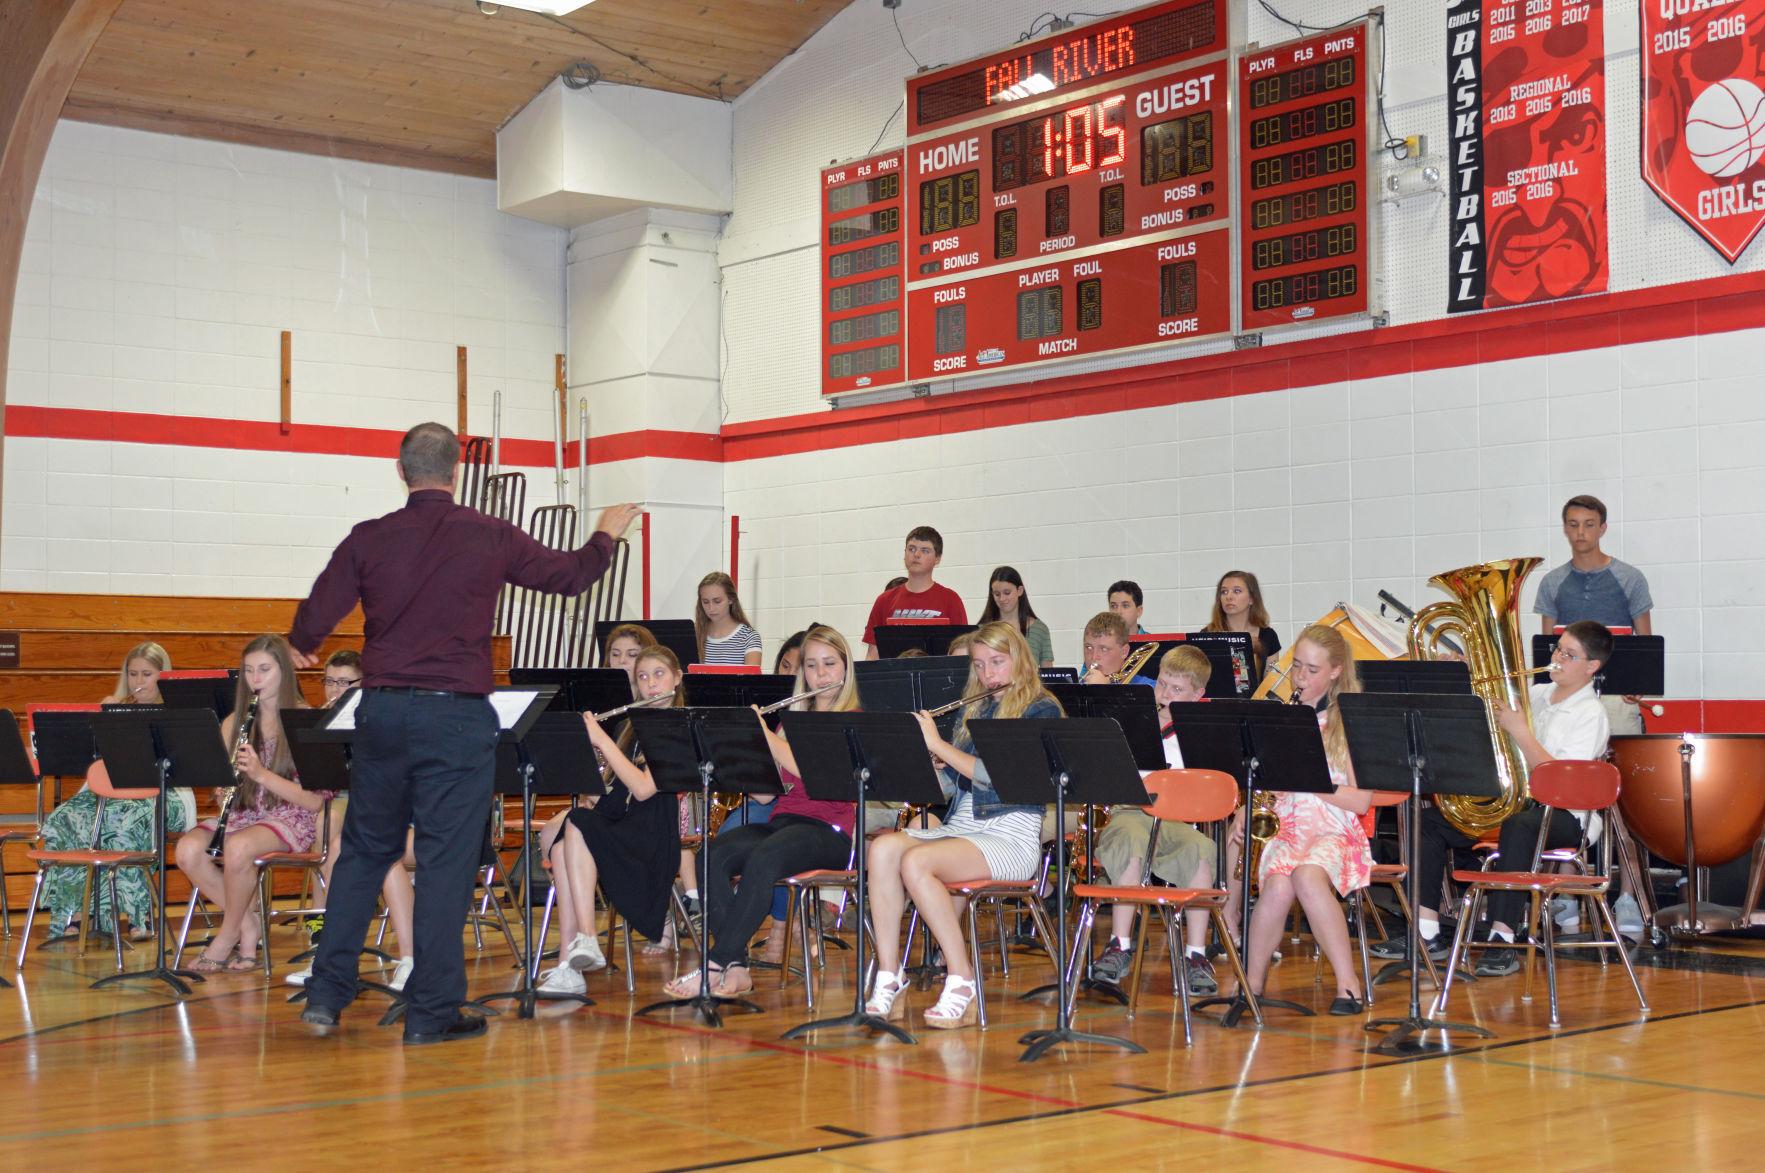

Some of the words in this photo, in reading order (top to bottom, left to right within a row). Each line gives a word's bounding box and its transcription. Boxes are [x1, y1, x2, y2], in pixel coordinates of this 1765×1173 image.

[1447, 9, 1480, 29] GIRLS
[1490, 6, 1515, 25] 2011
[1490, 24, 1515, 45] 2015
[1525, 15, 1551, 35] 2016
[1561, 4, 1590, 26] 2017
[1654, 26, 1691, 55] 2015
[1707, 14, 1746, 43] 2016
[1053, 26, 1135, 86] RIVER
[1249, 57, 1275, 73] PLYR
[1294, 47, 1314, 62] FLS
[1324, 37, 1354, 54] PNTS
[1135, 74, 1215, 118] GUEST
[1510, 74, 1571, 102] REGIONAL
[1490, 104, 1516, 124] 2013
[1525, 96, 1552, 116] 2015
[1561, 87, 1591, 108] 2016
[1044, 94, 1126, 177] 1:05
[919, 137, 980, 174] HOME
[1452, 29, 1480, 301] BASKETBALL
[827, 171, 846, 184] PLYR
[857, 165, 871, 176] FLS
[878, 158, 899, 171] PNTS
[1099, 168, 1125, 182] T.O.L.
[1507, 160, 1579, 187] SECTIONAL
[994, 193, 1017, 207] T.O.L.
[1164, 184, 1197, 203] POSS
[1492, 188, 1517, 207] 2015
[1526, 181, 1553, 200] 2016
[1697, 179, 1765, 221] GIRLS
[1141, 208, 1183, 230] BONUS
[932, 236, 959, 253] POSS
[1040, 235, 1076, 253] PERIOD
[1158, 242, 1196, 261] FOULS
[943, 252, 979, 270] BONUS
[1019, 268, 1060, 287] PLAYER
[1073, 260, 1102, 277] FOUL
[934, 287, 966, 303] FOULS
[1158, 318, 1198, 336] SCORE
[1039, 338, 1078, 355] MATCH
[933, 356, 967, 371] SCORE
